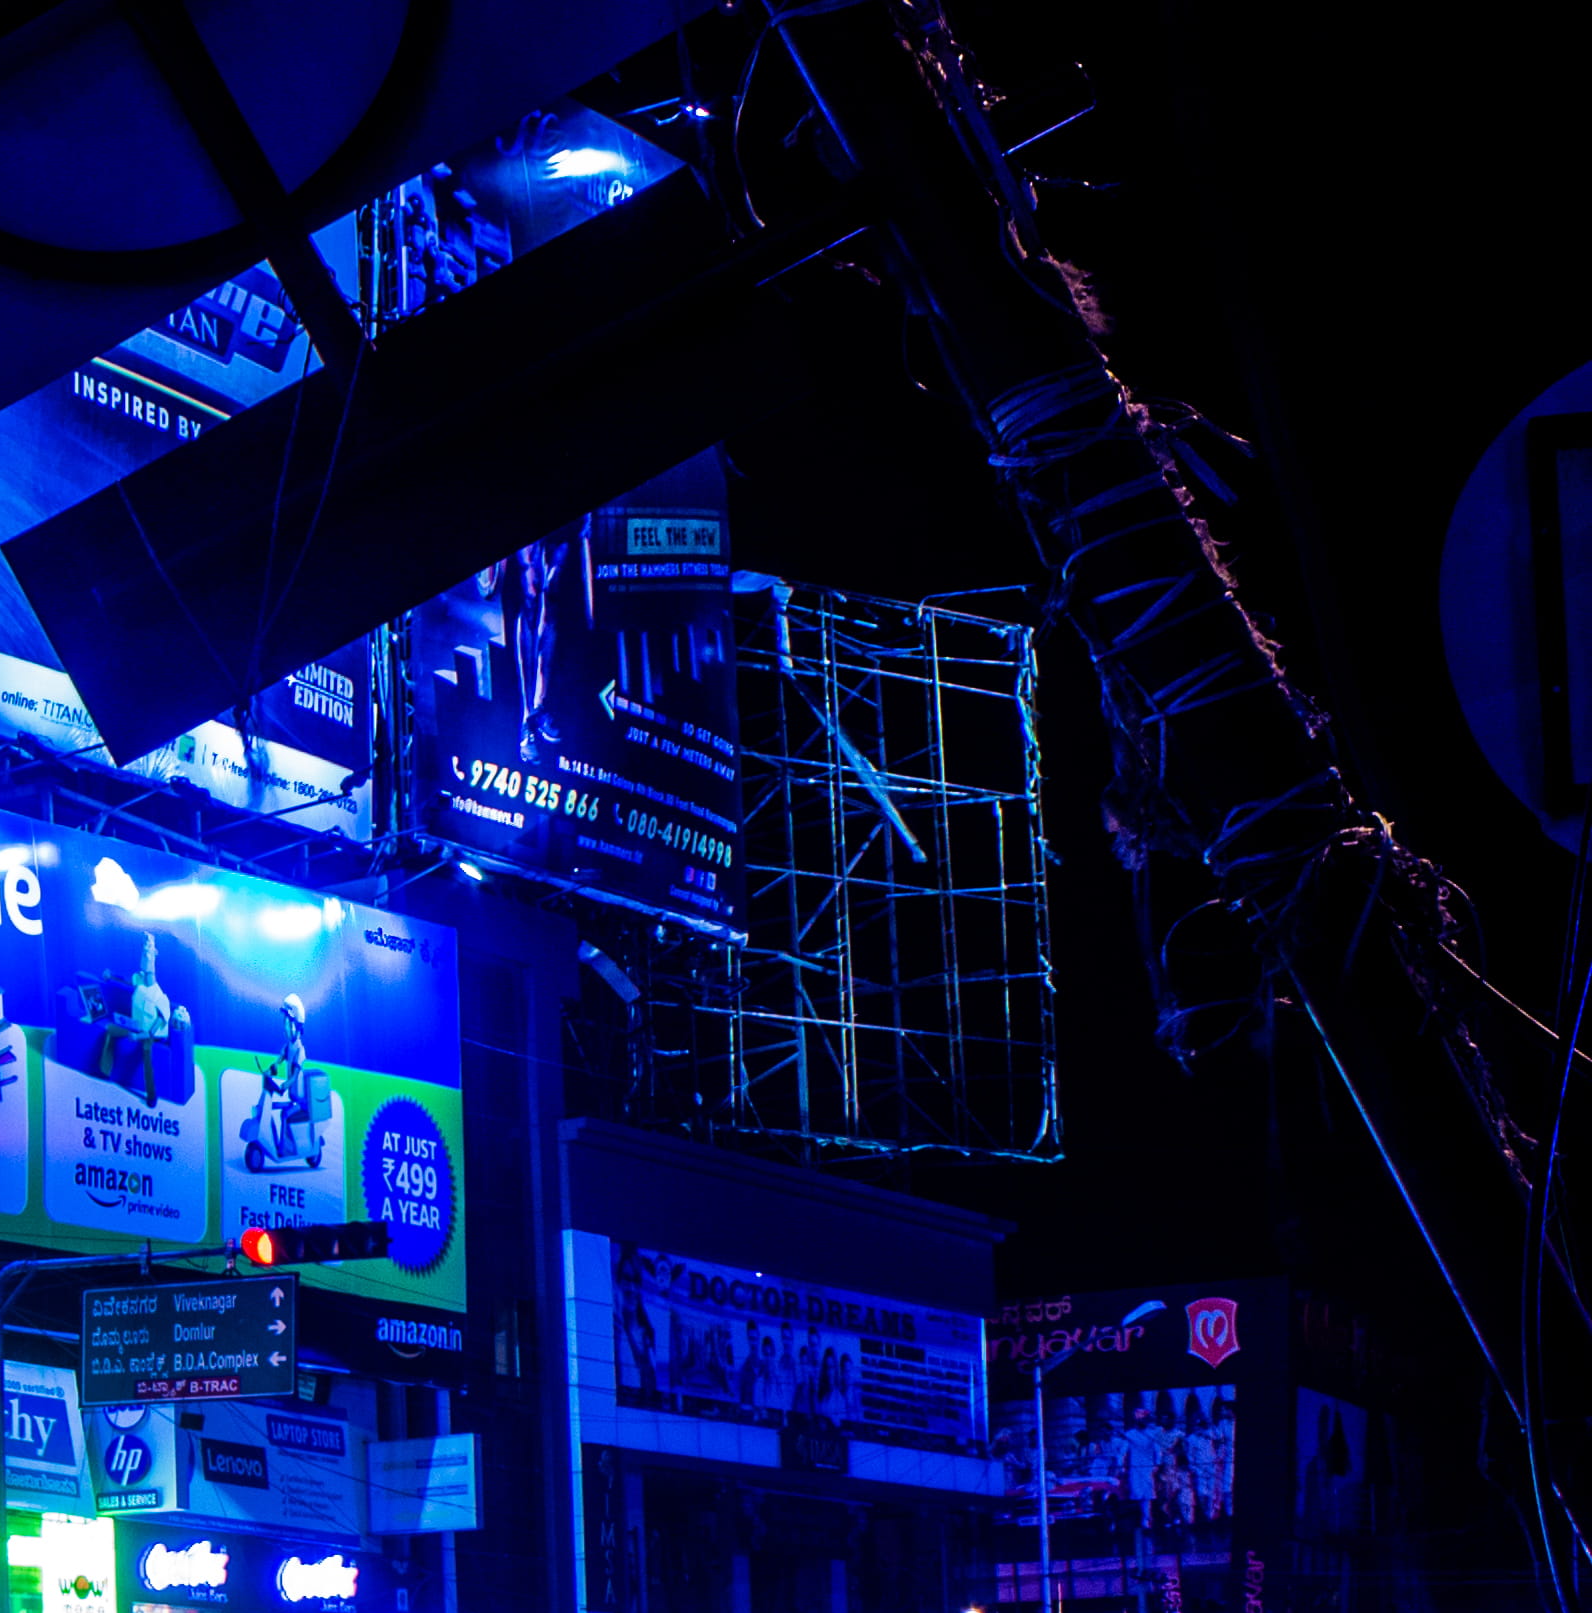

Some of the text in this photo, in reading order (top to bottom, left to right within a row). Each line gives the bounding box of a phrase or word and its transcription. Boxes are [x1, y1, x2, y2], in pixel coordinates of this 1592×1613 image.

[74, 371, 170, 431] INSPIRED
[634, 527, 661, 546] FEEL
[666, 527, 687, 546] THE
[1, 690, 38, 711] online:
[294, 685, 354, 728] EDITION
[470, 759, 600, 822] 9740 525 866
[75, 1097, 180, 1137] Latest Movies
[82, 1128, 173, 1162] & TV shows
[382, 1133, 436, 1160] AT JUST
[74, 1163, 153, 1197] amazon
[269, 1183, 305, 1209] FREE
[381, 1200, 440, 1230] A YEAR
[174, 1292, 237, 1315] Viveknagar
[688, 1271, 917, 1341] DOCTOR DREAMS
[174, 1323, 216, 1343] Domlur
[377, 1315, 462, 1352] amazon.in
[190, 1378, 238, 1394] B-TRAC
[270, 1421, 343, 1451] LAPTOP STORE
[110, 1434, 143, 1487] hp
[206, 1447, 264, 1478] Lenovo
[127, 1493, 157, 1506] SERVICE
